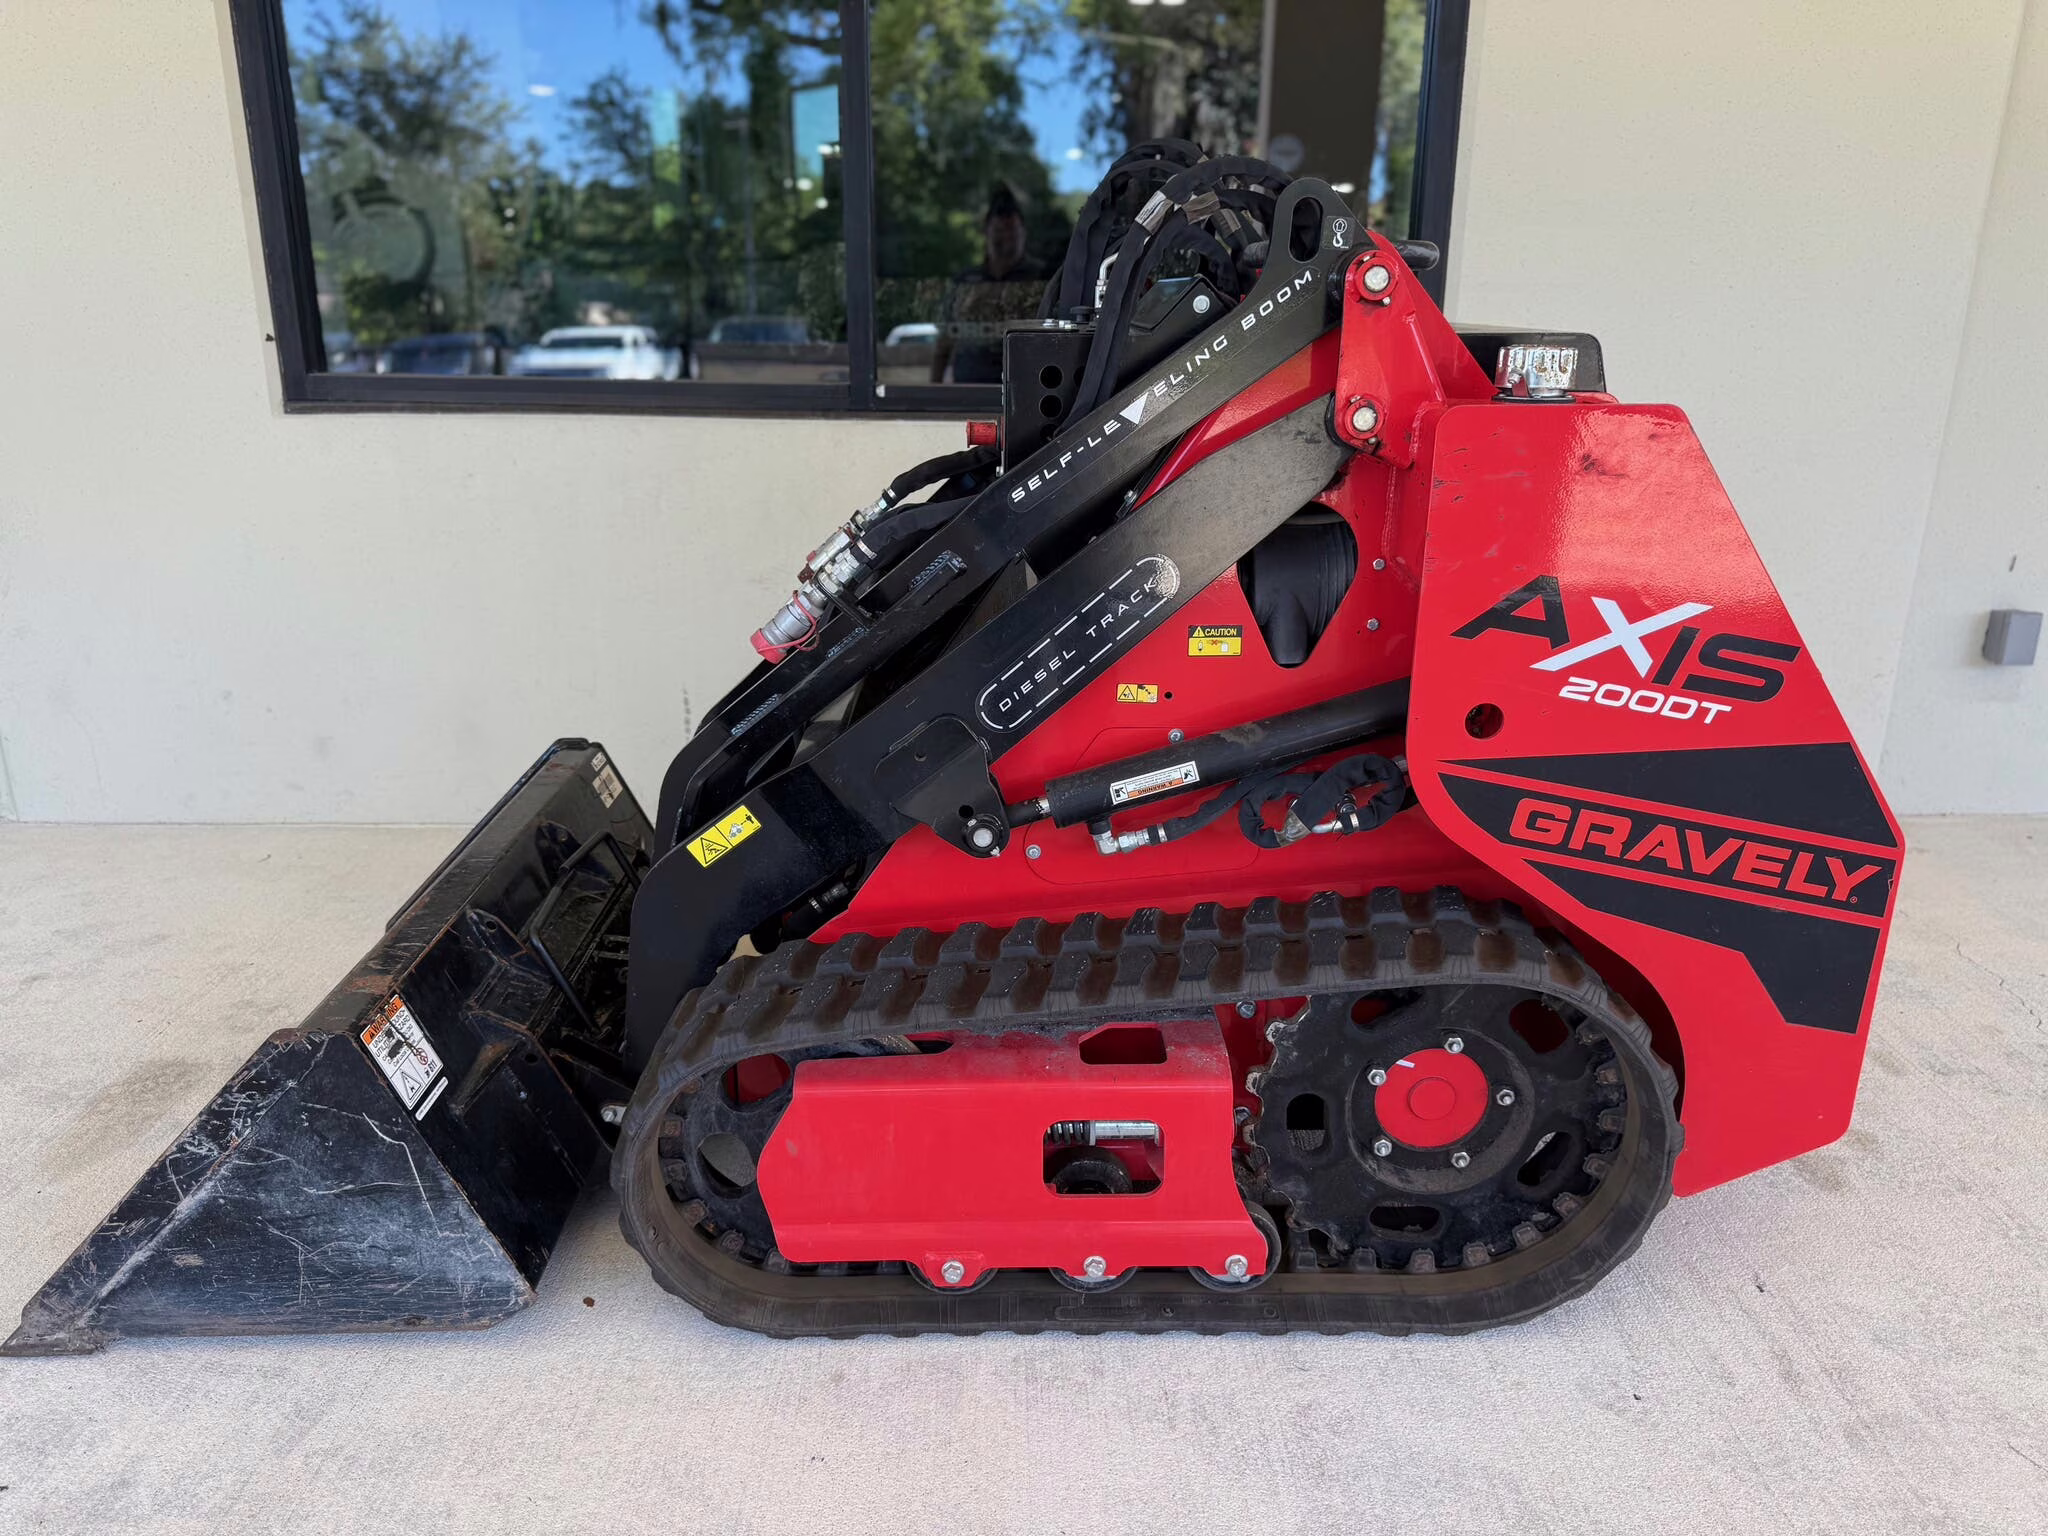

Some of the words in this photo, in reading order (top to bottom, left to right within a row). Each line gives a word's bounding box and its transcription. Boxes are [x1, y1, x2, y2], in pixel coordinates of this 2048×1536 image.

[1240, 270, 1312, 331] BOOM
[999, 648, 1076, 712] DIESEL
[1086, 576, 1159, 638] TRACK
[1204, 627, 1237, 637] CAUTION
[1450, 575, 1802, 702] AXIS
[1558, 676, 1733, 725] 200DT
[1509, 797, 1883, 903] GRAVELY
[370, 1001, 397, 1033] WARING
